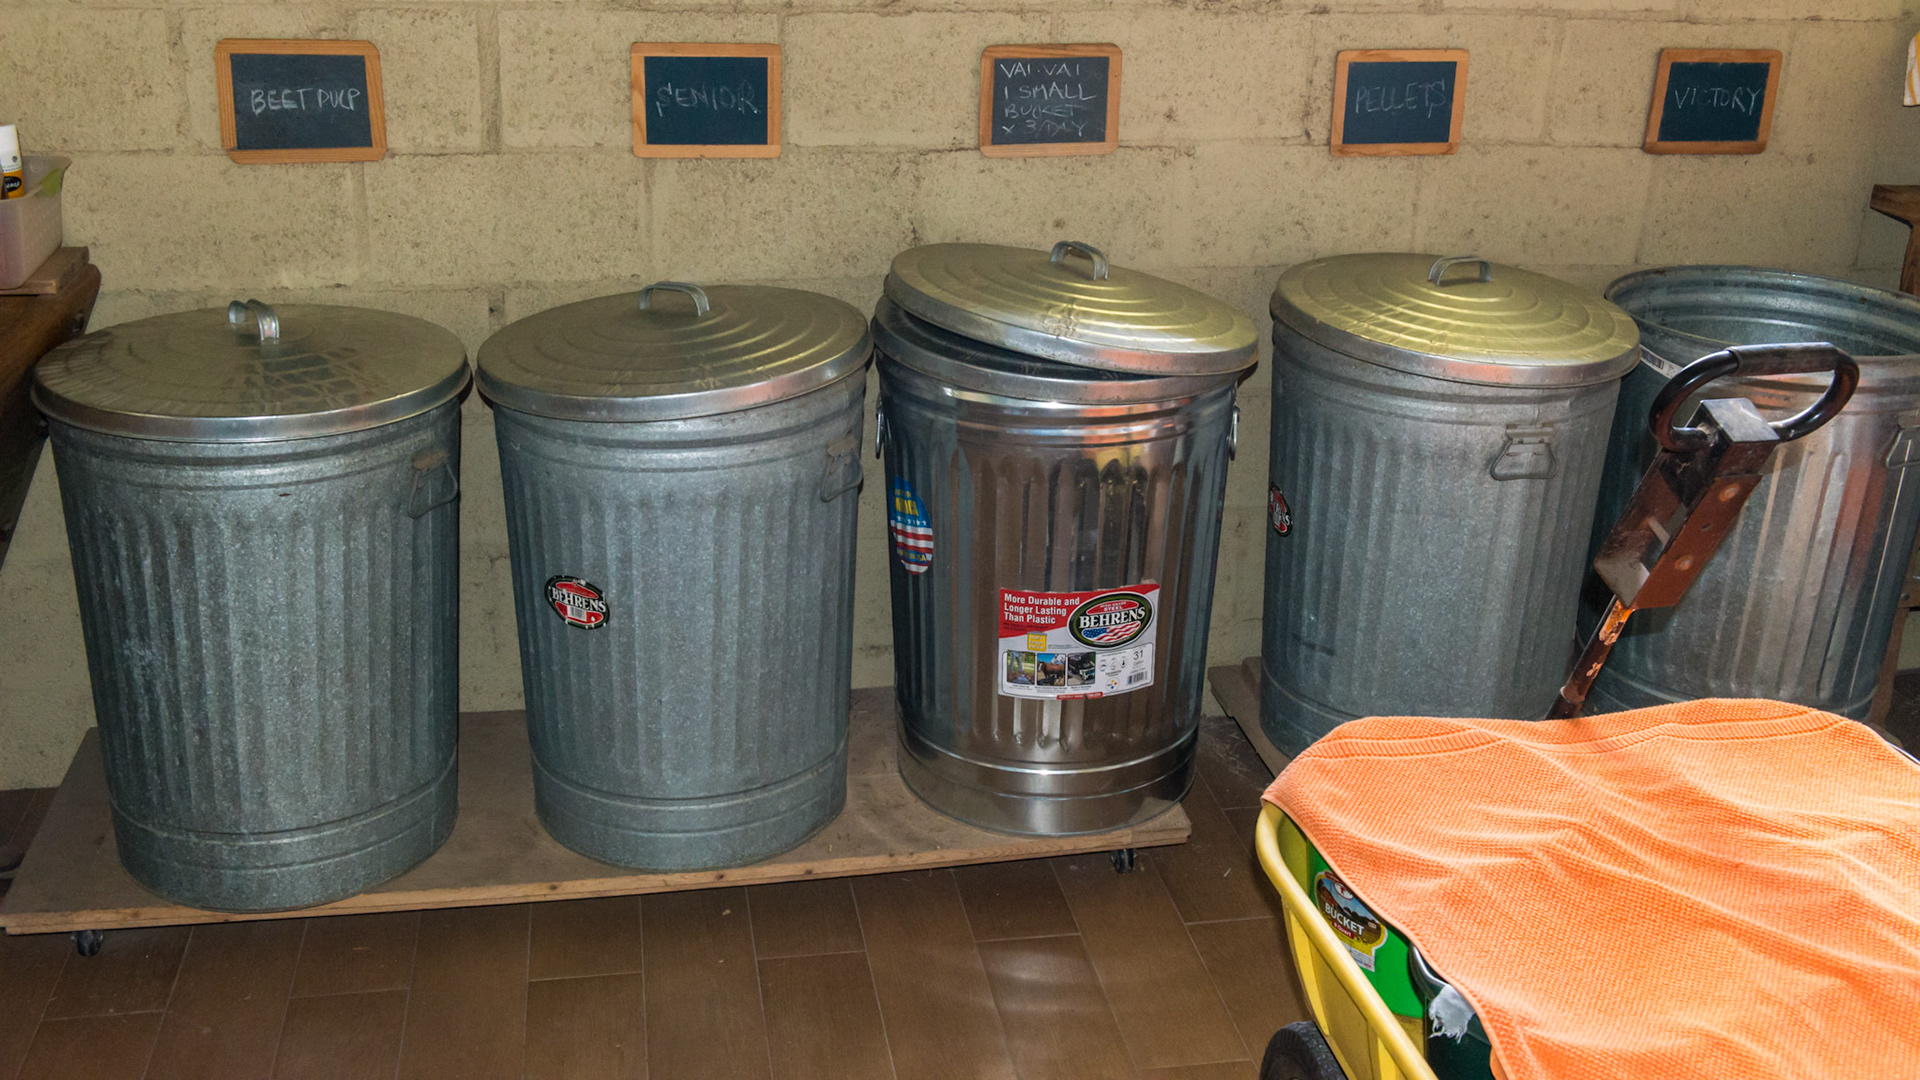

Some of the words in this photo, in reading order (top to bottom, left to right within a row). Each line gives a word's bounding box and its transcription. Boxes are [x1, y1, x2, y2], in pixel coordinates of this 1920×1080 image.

[250, 87, 313, 116] BEET
[317, 87, 361, 111] PULP
[655, 79, 762, 118] SENIOR
[1019, 82, 1098, 101] SMALL
[1355, 79, 1446, 119] PELLETS
[1674, 86, 1762, 116] VICTORY
[1004, 103, 1086, 119] BUCKET
[552, 587, 606, 613] BEHRENS
[1004, 593, 1025, 604] More
[1028, 596, 1061, 606] Durable
[1064, 597, 1080, 606] and
[1004, 602, 1033, 615] Longer
[1035, 606, 1067, 617] Lasting
[1004, 612, 1024, 622] Than
[1026, 614, 1056, 624] Plastic
[1079, 607, 1146, 628] BEHRENS
[1133, 649, 1144, 660] 31
[1325, 902, 1365, 936] BUCKET
